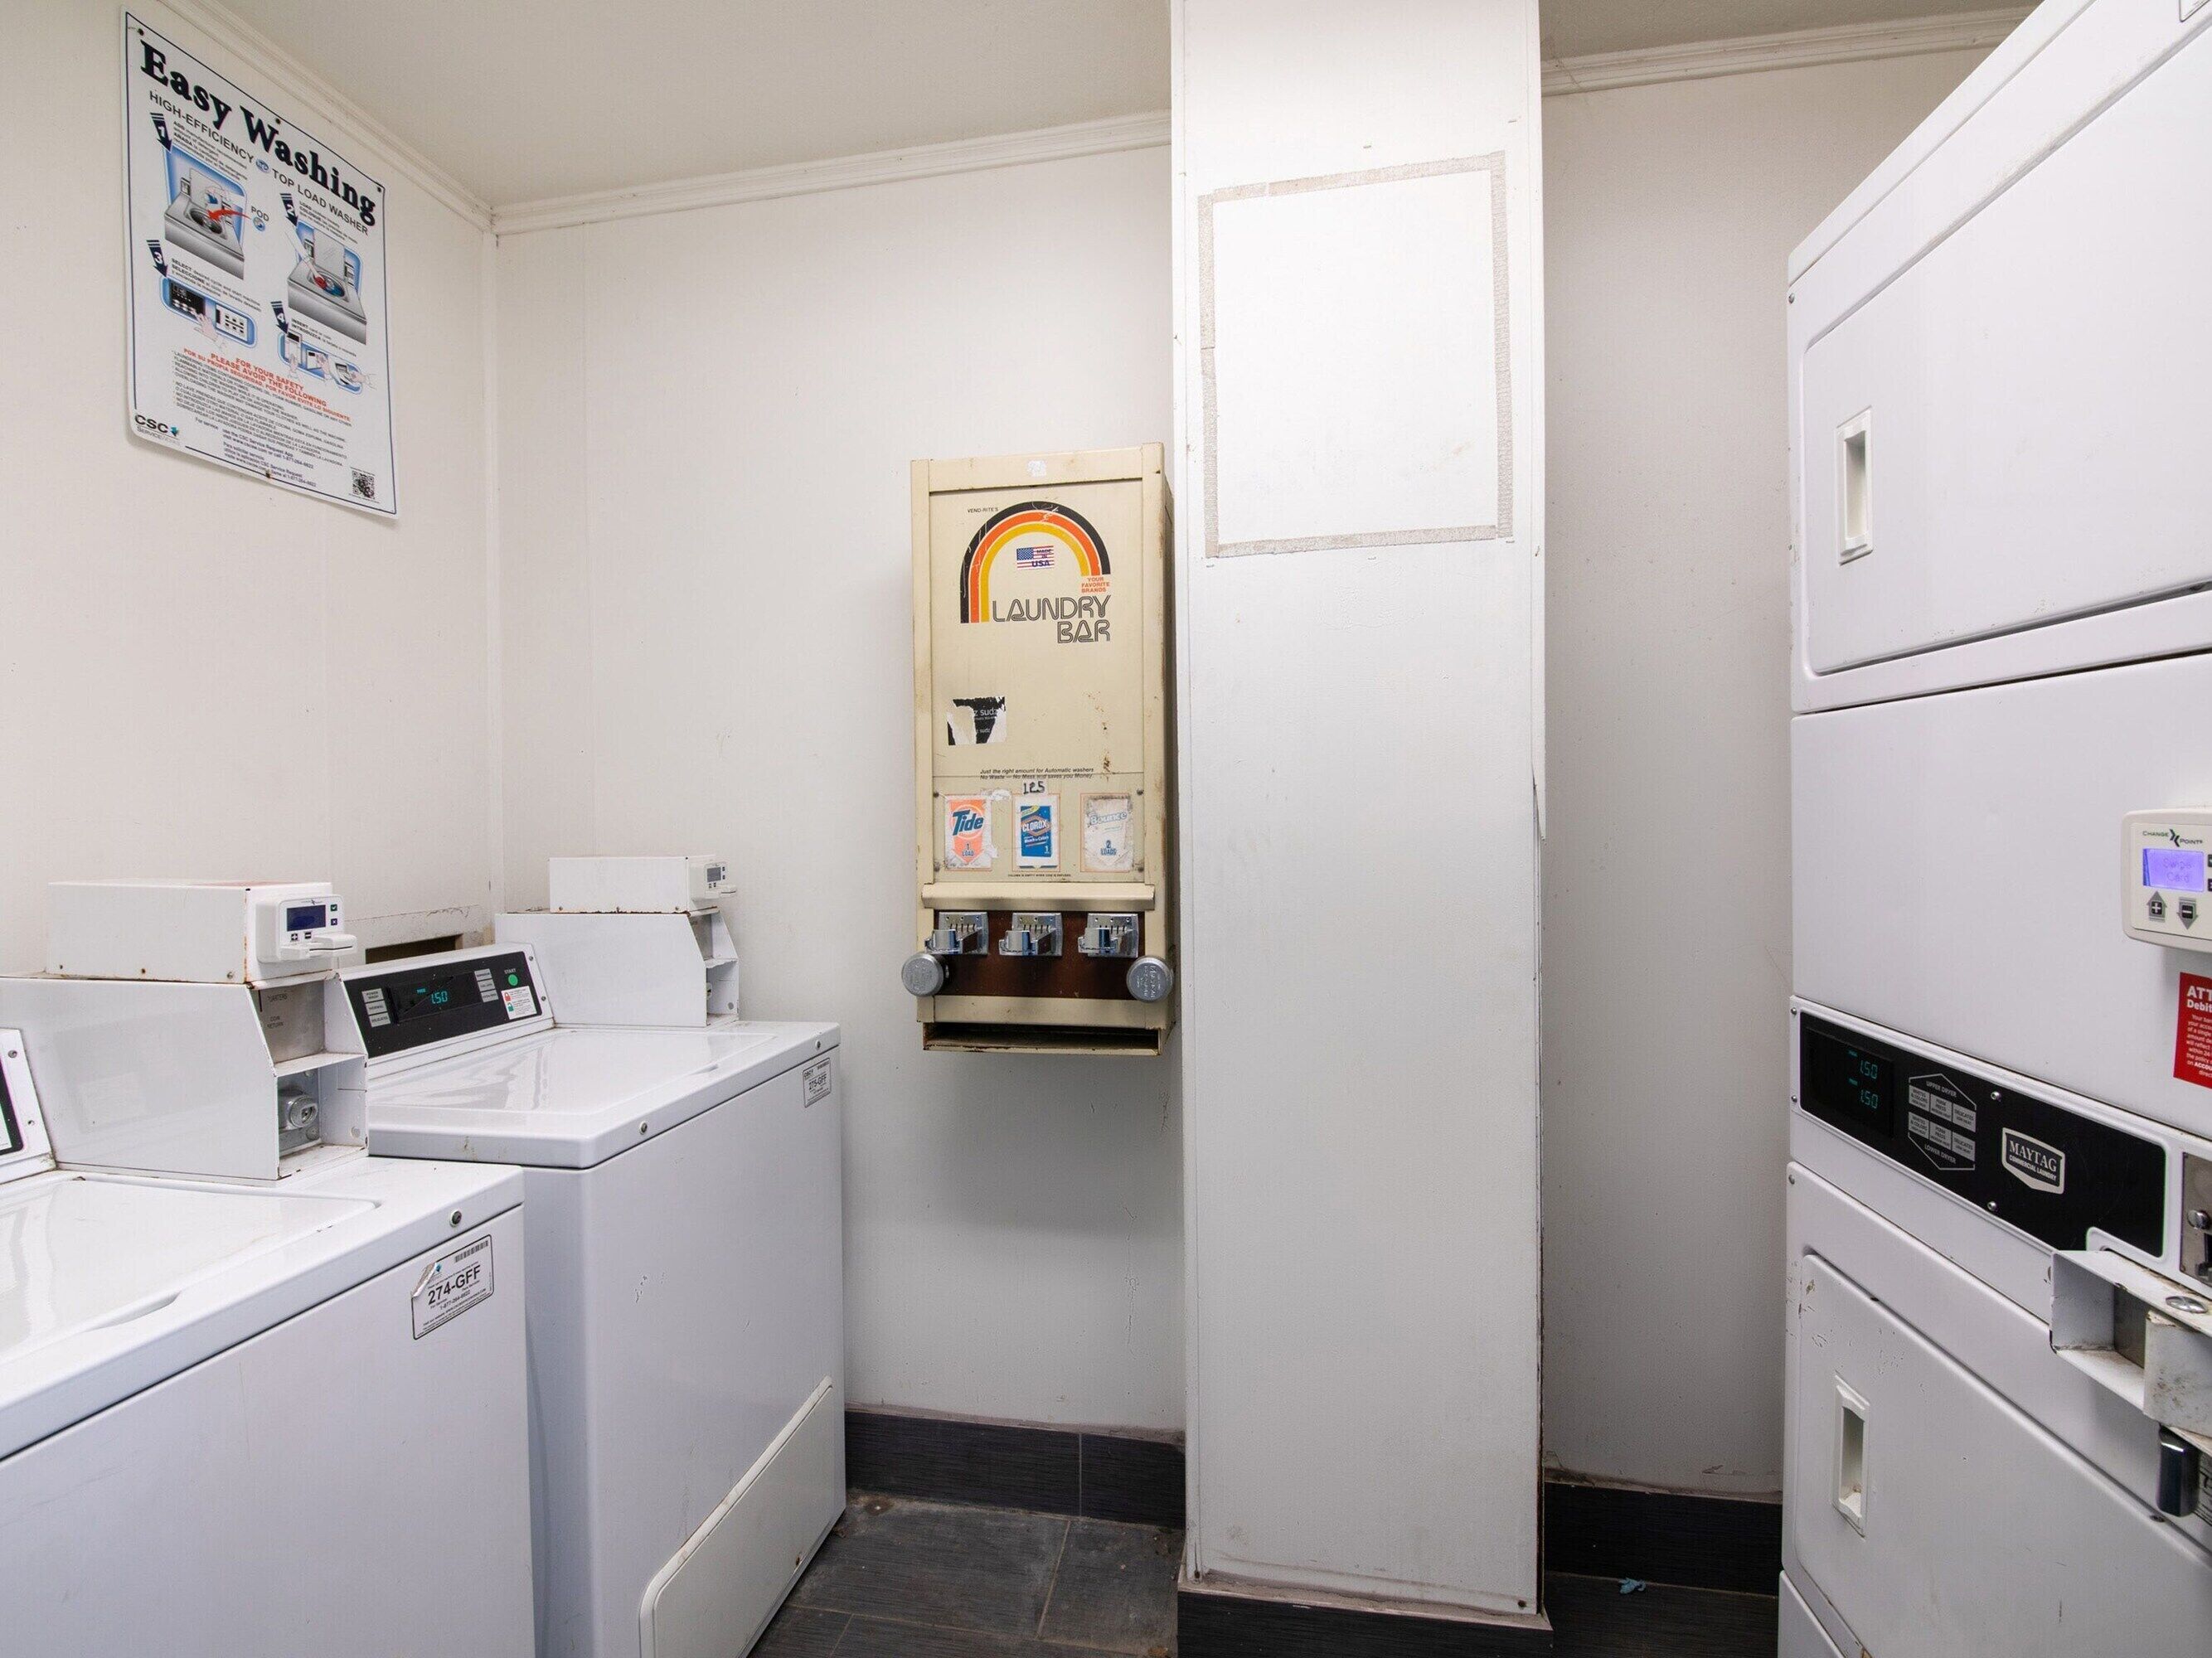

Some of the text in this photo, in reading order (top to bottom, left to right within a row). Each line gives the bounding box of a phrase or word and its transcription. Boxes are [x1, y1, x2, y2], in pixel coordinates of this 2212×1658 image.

[140, 39, 232, 131] Easy
[239, 104, 376, 227] Washing
[149, 90, 255, 164] HIGH-EFFICIENCY
[158, 125, 165, 138] 1
[272, 168, 294, 188] TOP
[298, 182, 327, 209] LOAD
[328, 205, 370, 236] WASHER
[285, 204, 295, 216] 2
[250, 206, 270, 222] POD
[154, 251, 163, 264] 3
[277, 313, 285, 322] 4
[290, 317, 308, 330] INSERT
[211, 352, 240, 371] PLEASE
[241, 366, 266, 382] AVOID
[267, 376, 284, 390] THE
[284, 384, 327, 407] FOLLOWING
[235, 356, 252, 370] FOR
[252, 364, 274, 380] YOUR
[275, 374, 304, 392] SAFETY
[134, 414, 169, 434] CSC
[992, 594, 1111, 622] LAUNDRY
[1057, 619, 1111, 643] BAR
[953, 809, 984, 836] Tide
[1022, 819, 1047, 831] CLOROX
[1089, 812, 1128, 826] Bounce
[1106, 840, 1111, 848] 2
[2186, 999, 2212, 1013] Debit
[2010, 1140, 2057, 1172] MAYTAG
[428, 1264, 481, 1306] 274-GFF
